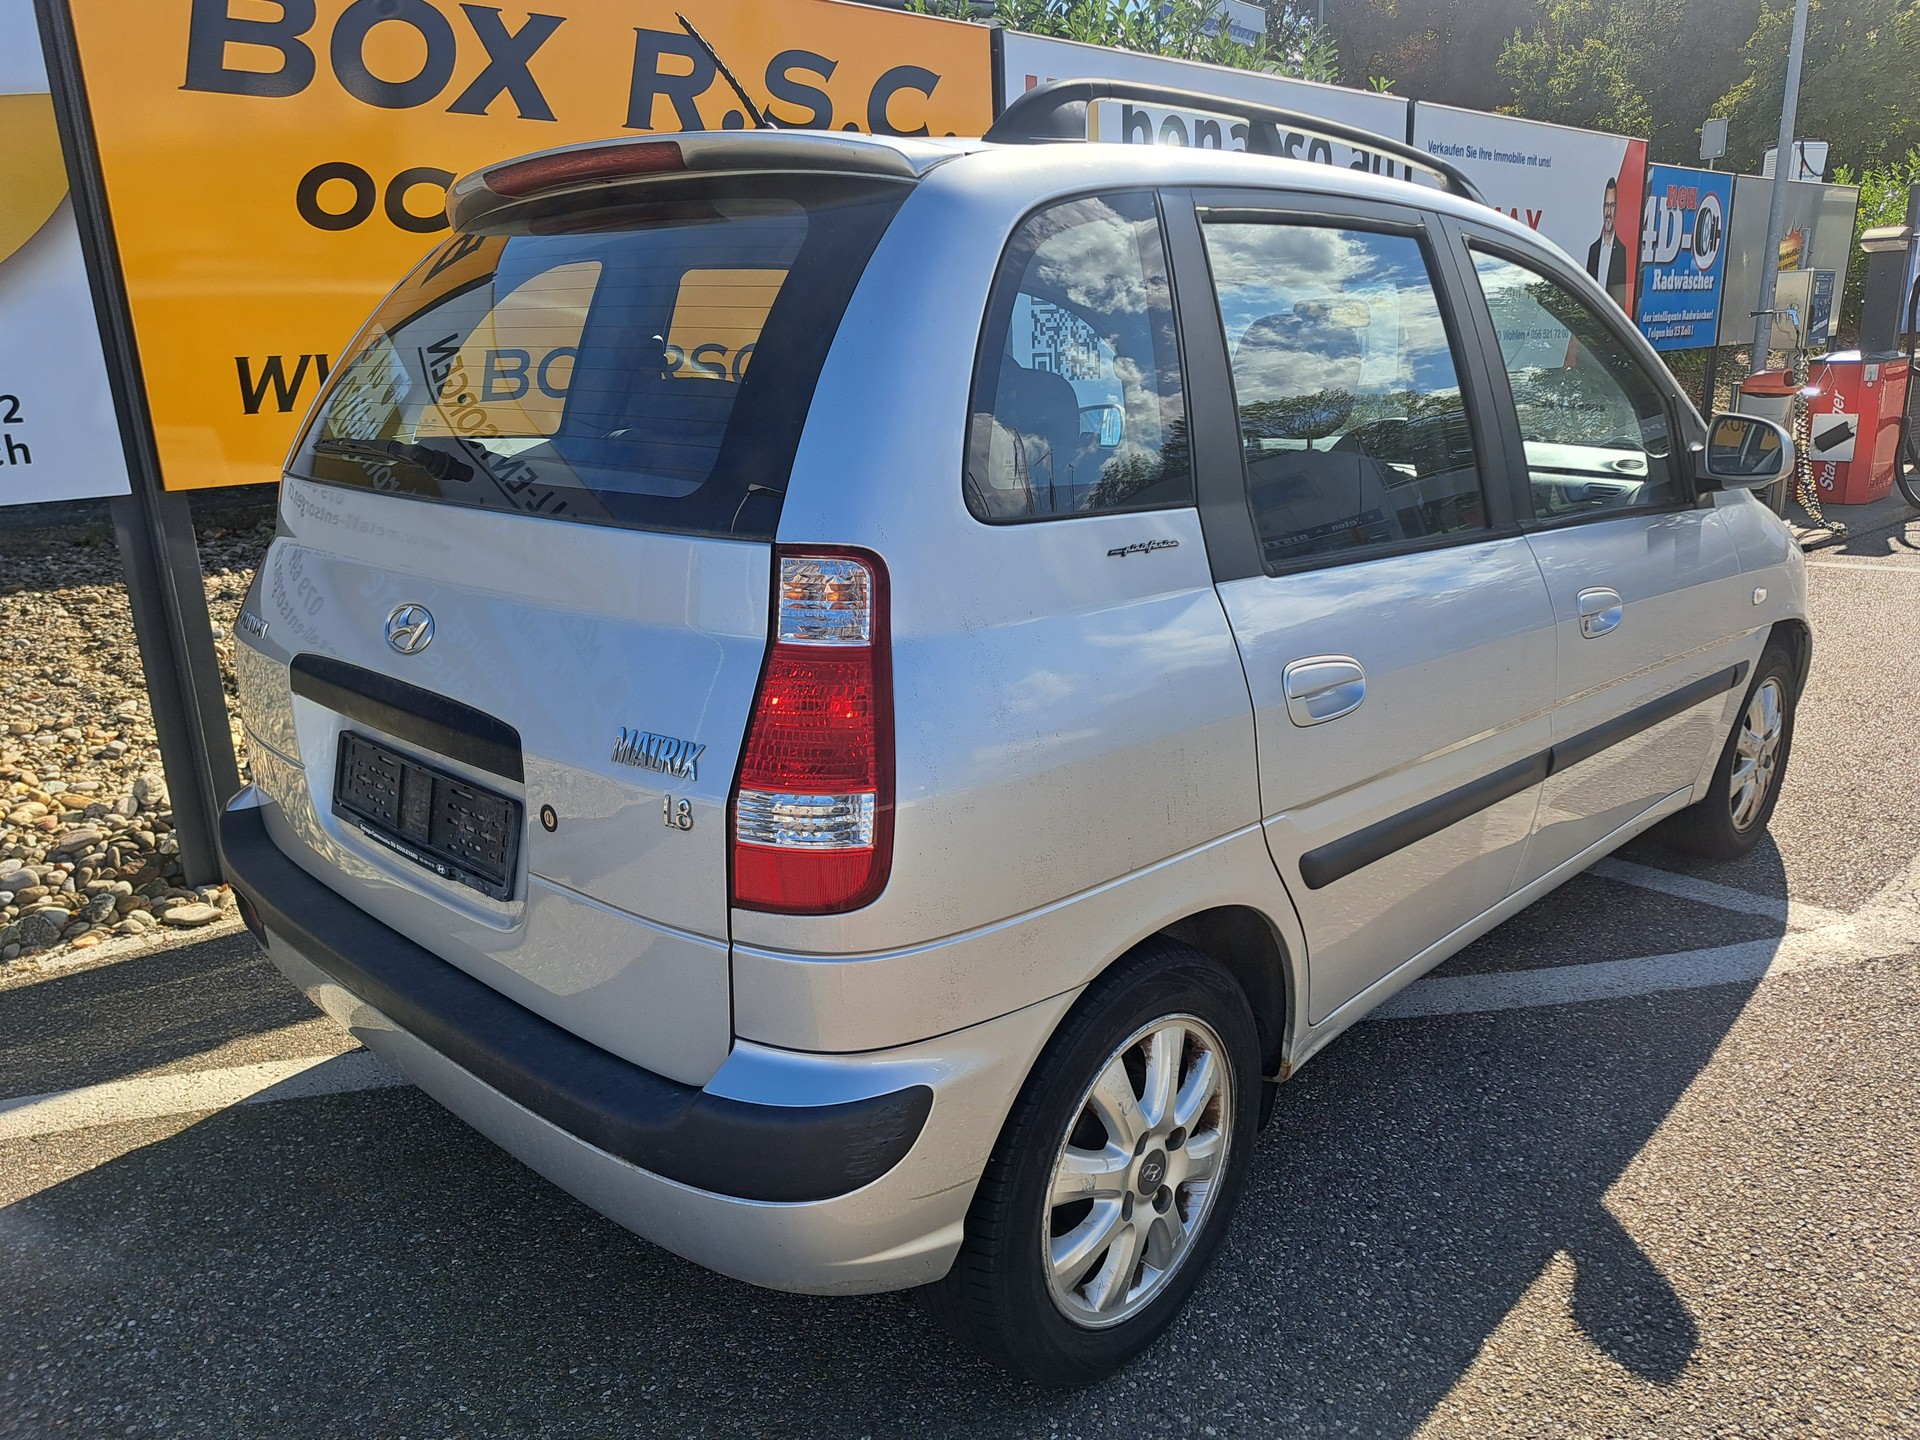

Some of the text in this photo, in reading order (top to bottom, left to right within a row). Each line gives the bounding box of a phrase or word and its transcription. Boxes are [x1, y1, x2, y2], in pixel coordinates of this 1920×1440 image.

[178, 0, 957, 138] BOX R.S.C
[1427, 140, 1552, 168] Verkaufen Sie Ihre Immobilie mit uns!
[1666, 185, 1698, 210] neu
[1652, 268, 1714, 291] Radwäscher
[1642, 311, 1653, 323] der
[1652, 310, 1682, 324] intelligente
[1647, 327, 1666, 340] Felgen
[1665, 325, 1674, 337] bis
[0, 394, 24, 424] 2
[0, 433, 32, 466] h
[611, 726, 707, 781] MATRIX
[663, 794, 694, 832] 1.8
